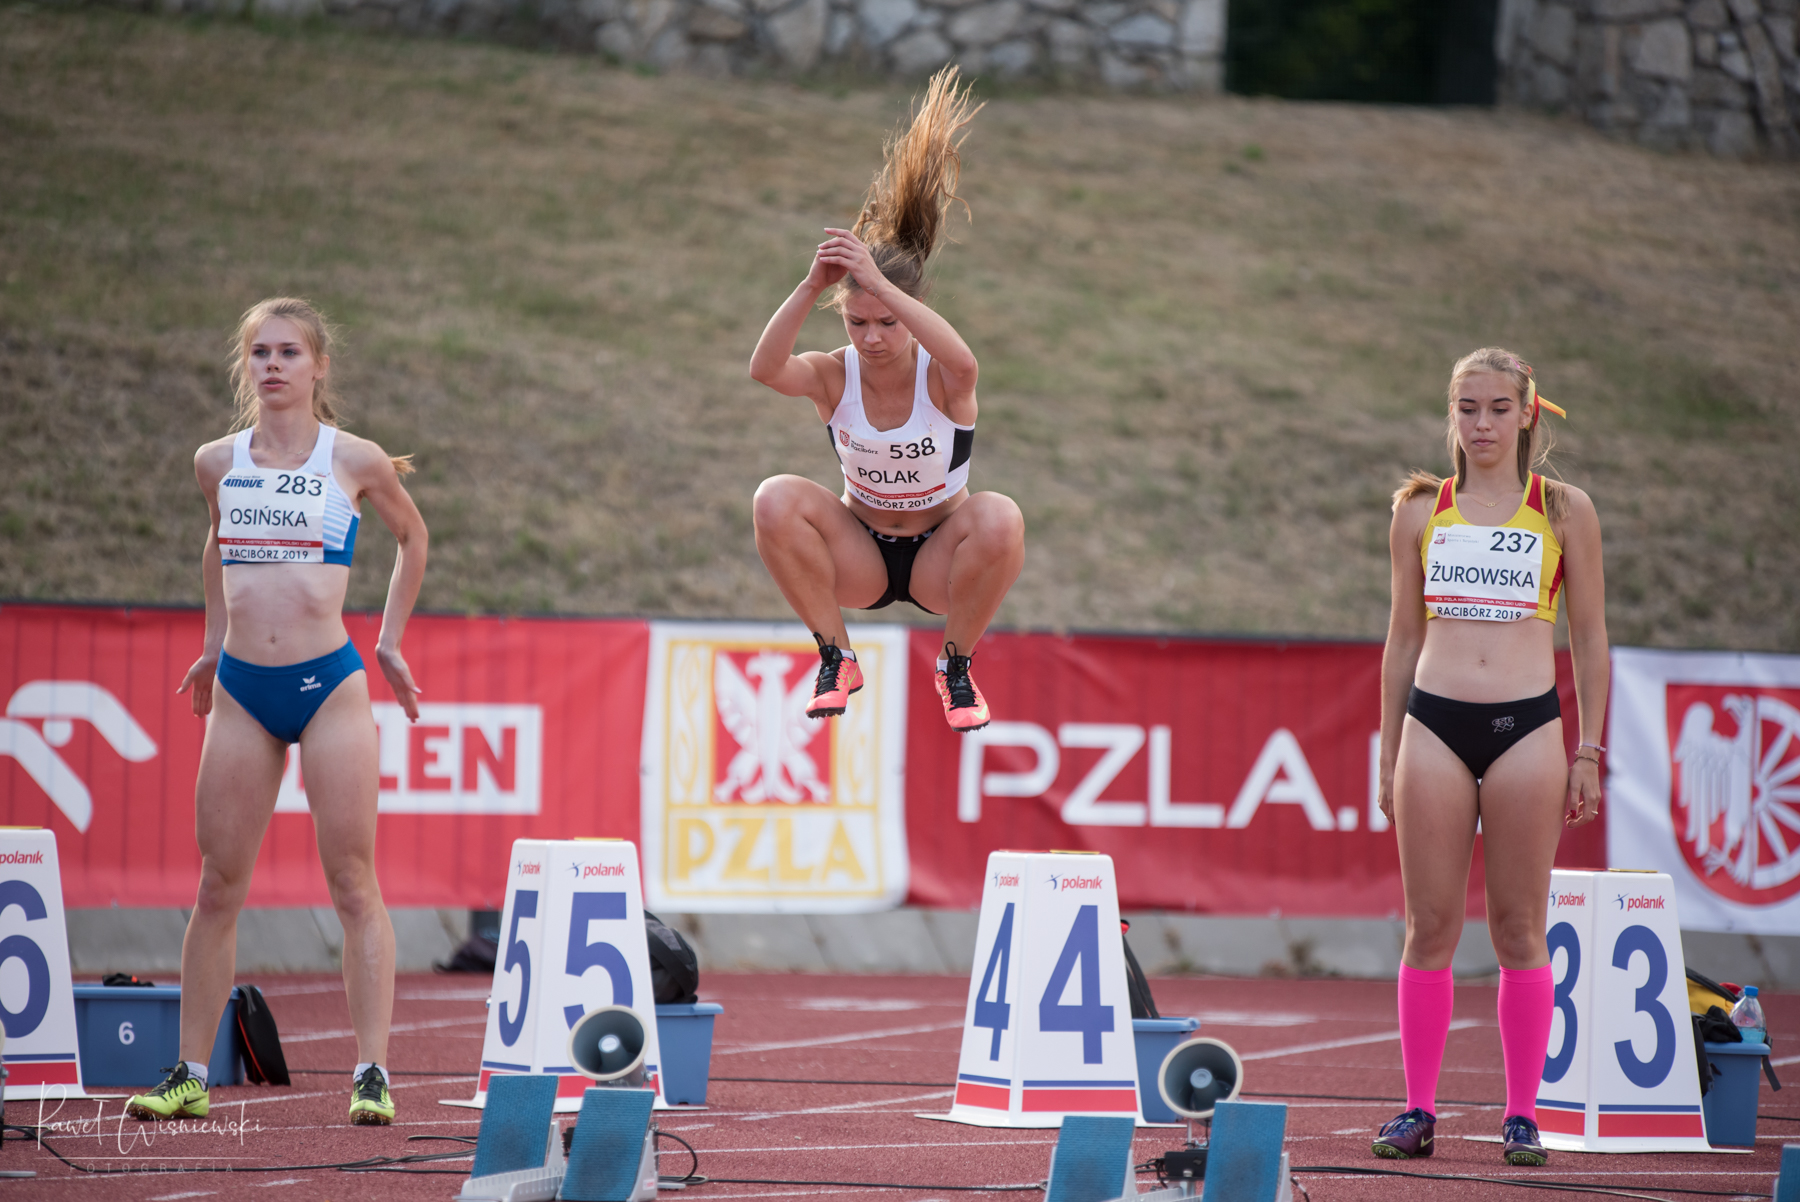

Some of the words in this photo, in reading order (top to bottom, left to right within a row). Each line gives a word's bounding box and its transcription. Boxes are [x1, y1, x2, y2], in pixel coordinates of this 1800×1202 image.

[890, 437, 936, 459] 538
[223, 478, 265, 488] 4MOVE
[275, 474, 322, 496] 283
[857, 466, 920, 484] POLAK
[855, 488, 904, 509] RACIBÓRZ
[908, 496, 933, 508] 2019
[230, 506, 308, 527] OSIŃSKA
[229, 547, 279, 559] RACIBÓRZ
[282, 550, 308, 559] 2019
[1490, 531, 1538, 554] 237
[1430, 561, 1534, 588] ŻUROWSKA
[1437, 605, 1492, 618] RACIBÓRZ
[1494, 610, 1522, 620] 2019
[676, 817, 868, 881] PZLA
[522, 862, 541, 877] polanik
[583, 863, 625, 879] polanik
[999, 874, 1020, 889] polanik
[1061, 876, 1103, 892] polanik
[1557, 892, 1586, 909] polanik
[1627, 895, 1665, 911] polanik
[0, 879, 50, 1039] 6
[498, 889, 539, 1048] 5
[562, 891, 634, 1034] 5
[973, 902, 1015, 1062] 4
[1039, 904, 1115, 1064] 4
[1540, 922, 1581, 1084] 3
[1611, 924, 1676, 1089] 3
[118, 1021, 135, 1045] 6
